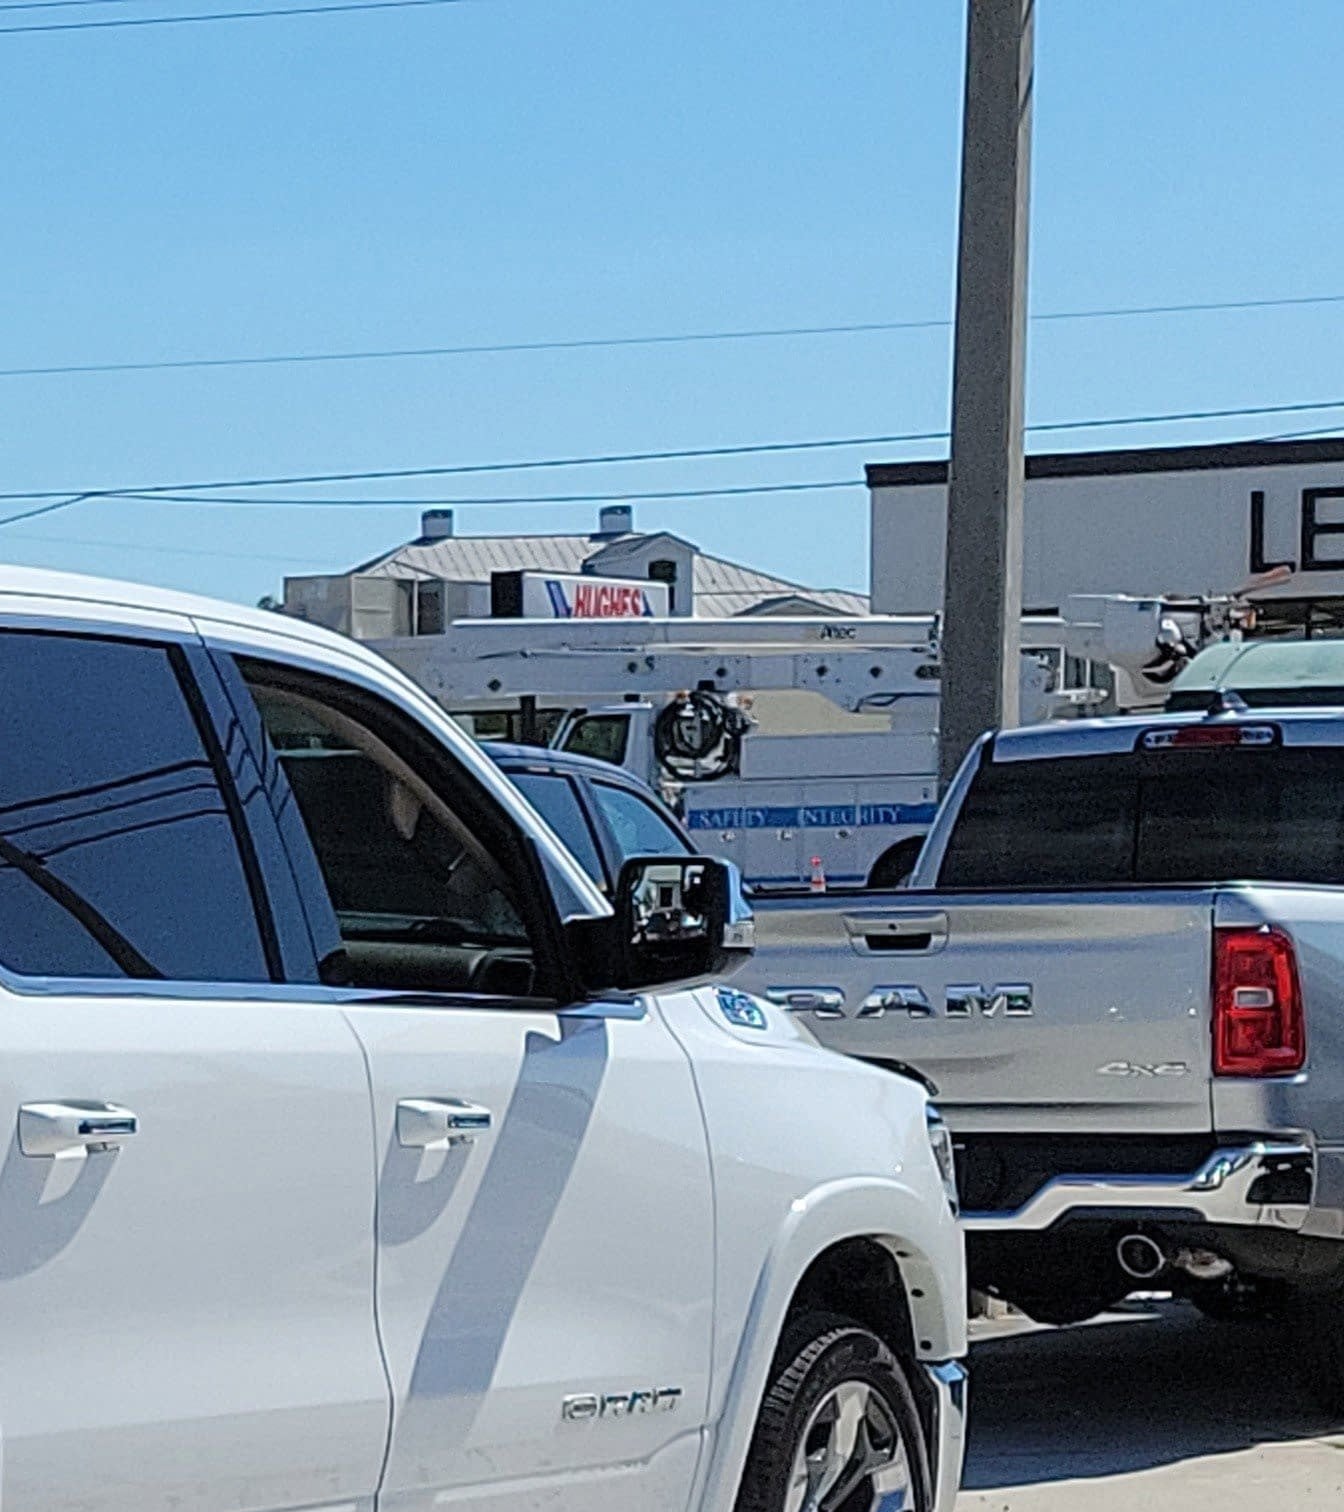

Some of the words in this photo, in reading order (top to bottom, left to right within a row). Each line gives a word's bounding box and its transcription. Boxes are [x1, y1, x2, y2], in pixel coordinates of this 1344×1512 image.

[1250, 487, 1344, 573] LE
[573, 584, 644, 617] HUGHES
[765, 982, 1033, 1019] RAM
